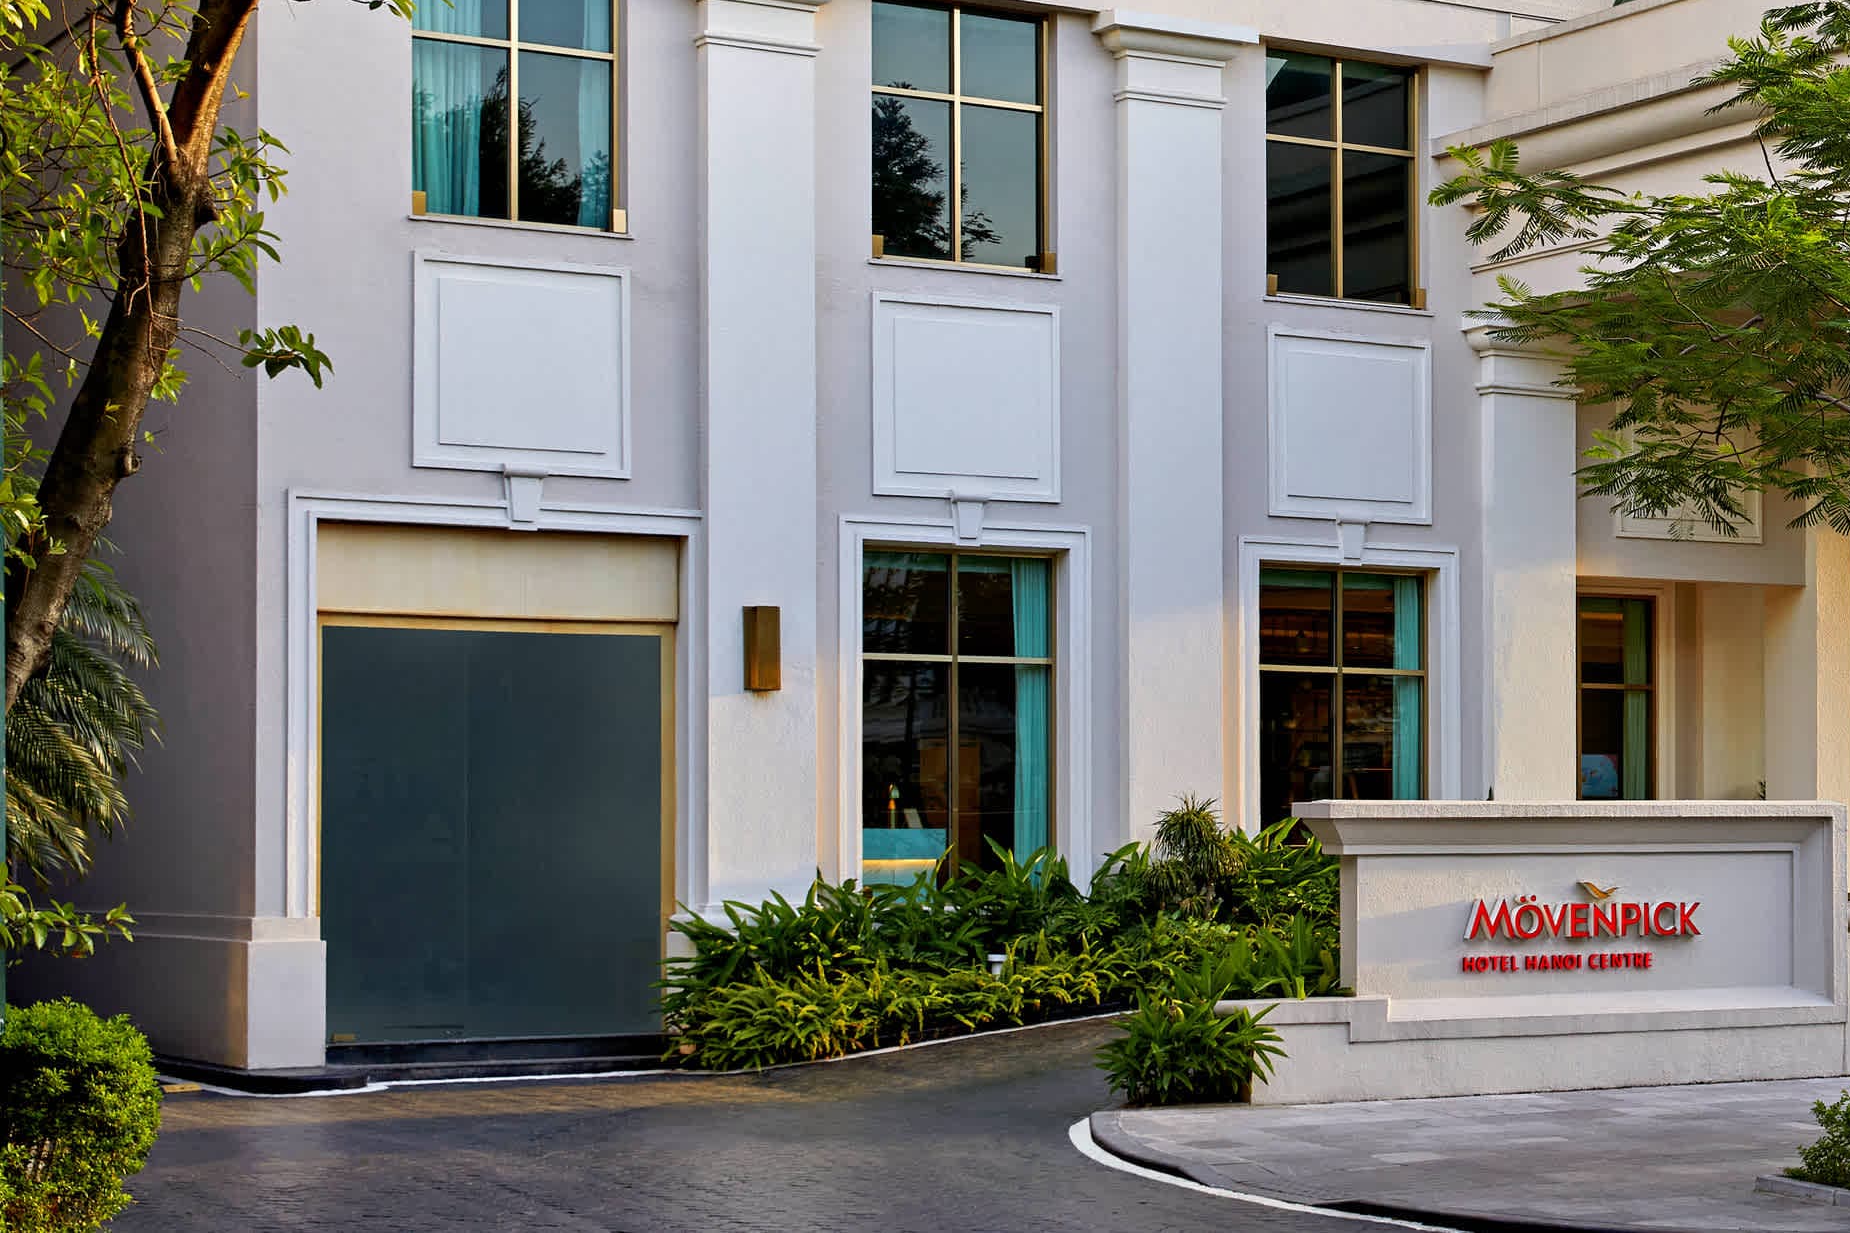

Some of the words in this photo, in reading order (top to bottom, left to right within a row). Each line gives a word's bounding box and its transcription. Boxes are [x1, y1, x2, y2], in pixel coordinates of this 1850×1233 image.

[1466, 894, 1702, 940] MÖVENPICK
[1462, 955, 1519, 972] HOTEL
[1525, 954, 1583, 971] HANOI
[1588, 952, 1653, 970] CENTRE
